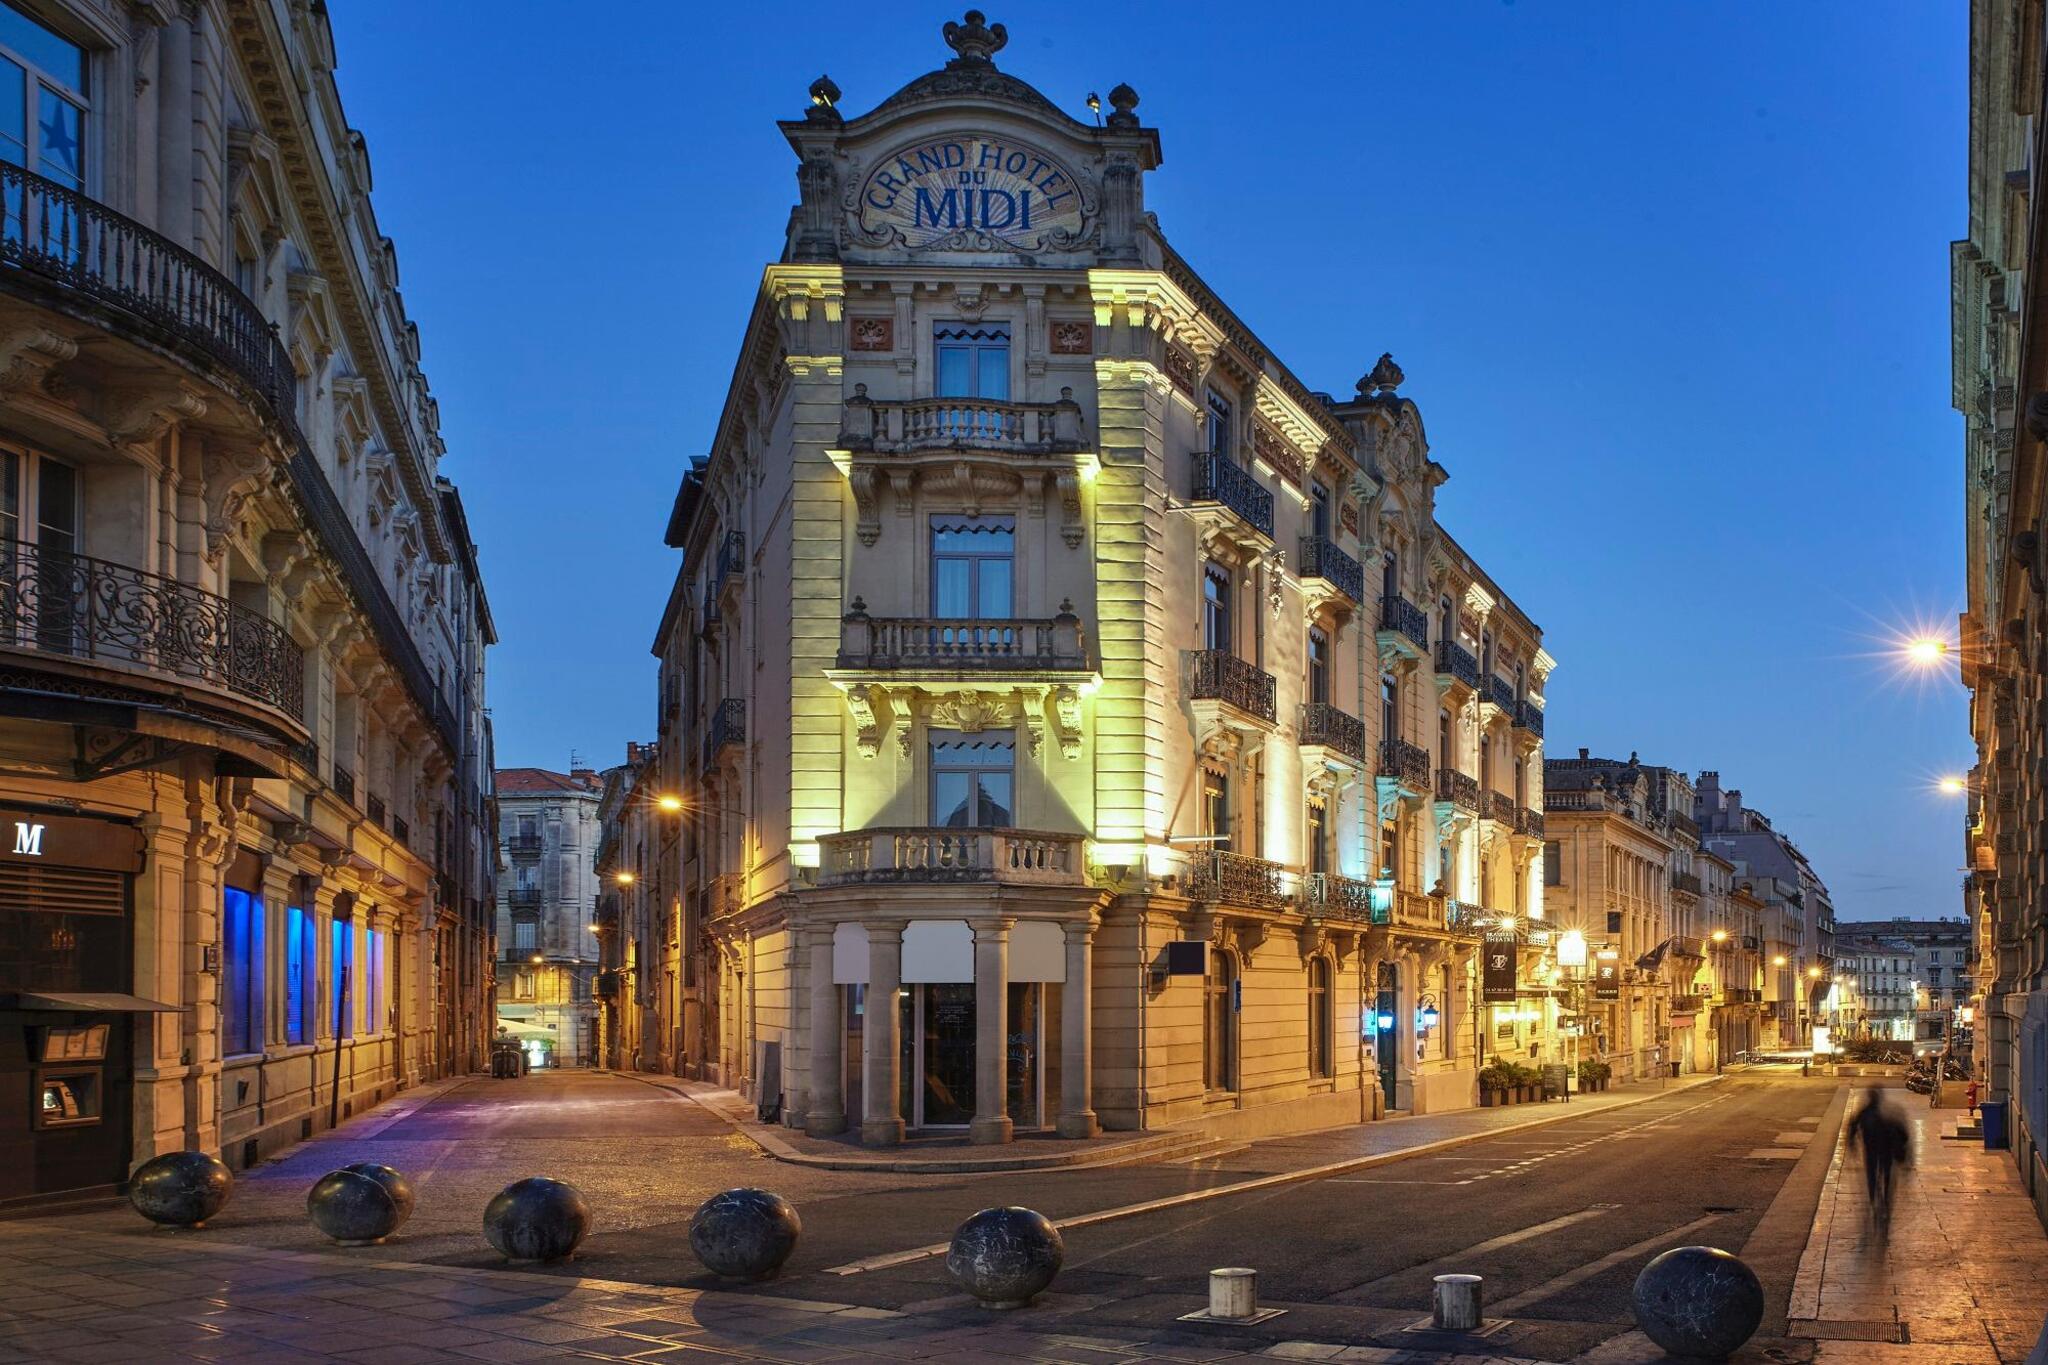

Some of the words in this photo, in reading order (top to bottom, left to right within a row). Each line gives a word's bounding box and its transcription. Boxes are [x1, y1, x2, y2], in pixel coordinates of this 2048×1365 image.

[867, 144, 966, 210] GRAND
[978, 143, 1075, 211] HOTEL
[957, 170, 987, 185] DU
[913, 187, 1033, 230] MIDI
[12, 822, 45, 856] M
